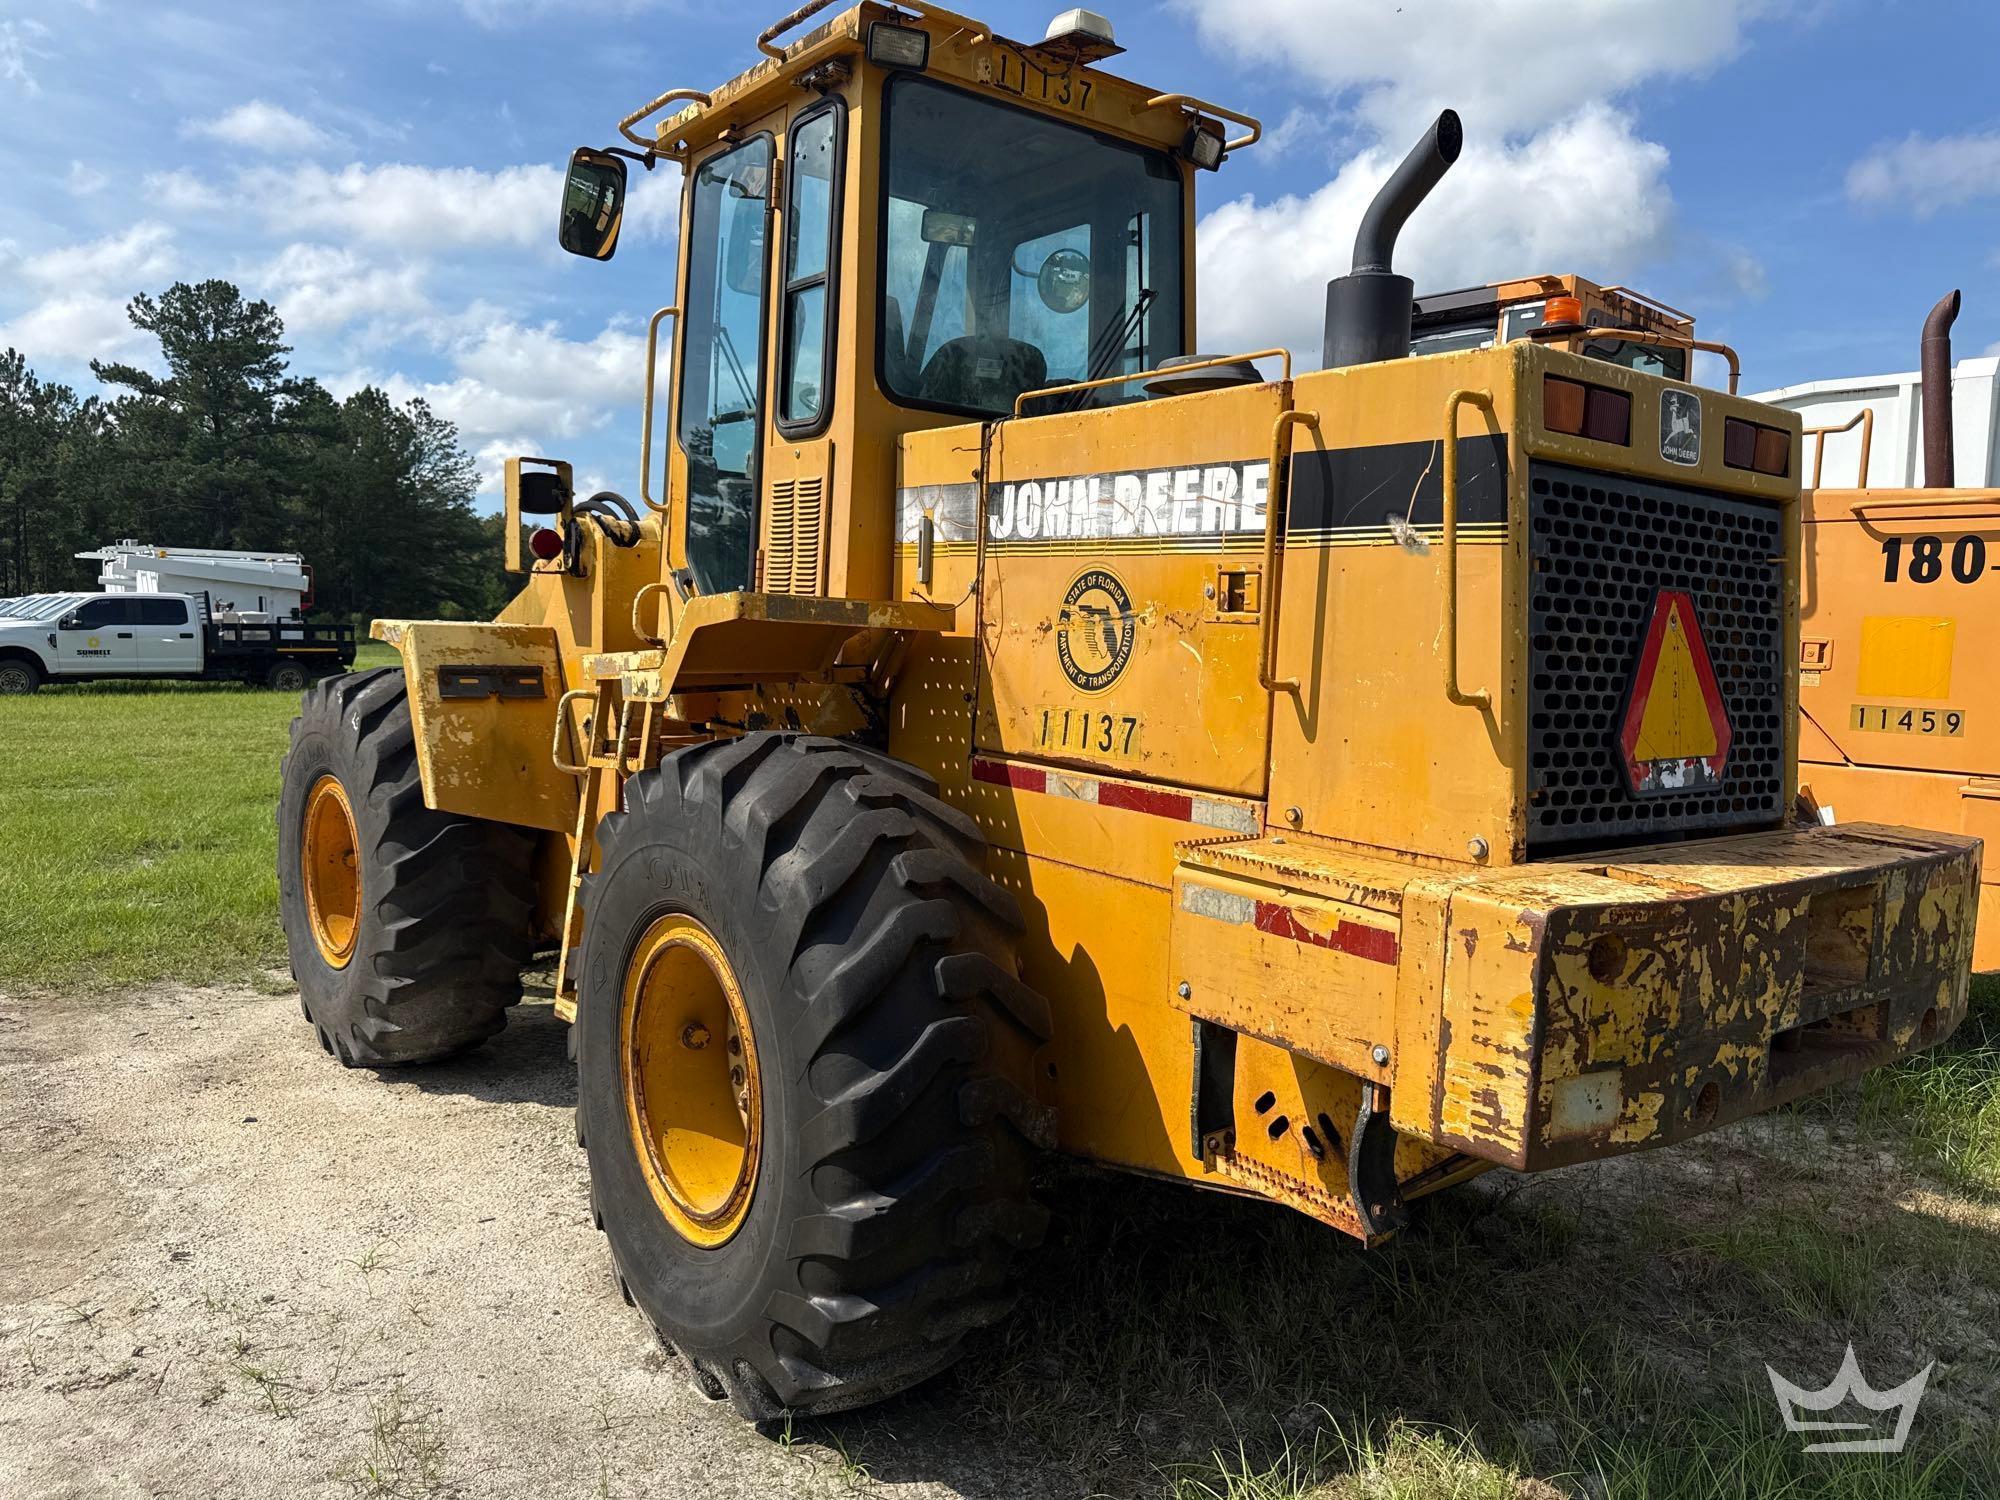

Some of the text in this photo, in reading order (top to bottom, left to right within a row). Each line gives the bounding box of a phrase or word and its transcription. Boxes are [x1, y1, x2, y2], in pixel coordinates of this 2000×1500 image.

[1000, 54, 1093, 112] 11137
[1662, 445, 1698, 460] JOHN DEERE
[989, 463, 1270, 539] JOHN DEERE
[1067, 574, 1125, 606] STATE OF FLORIDA
[1059, 617, 1132, 687] PARTMENT OF TRANSPORTATION
[1041, 710, 1137, 755] 11137
[1859, 707, 1961, 735] 11459
